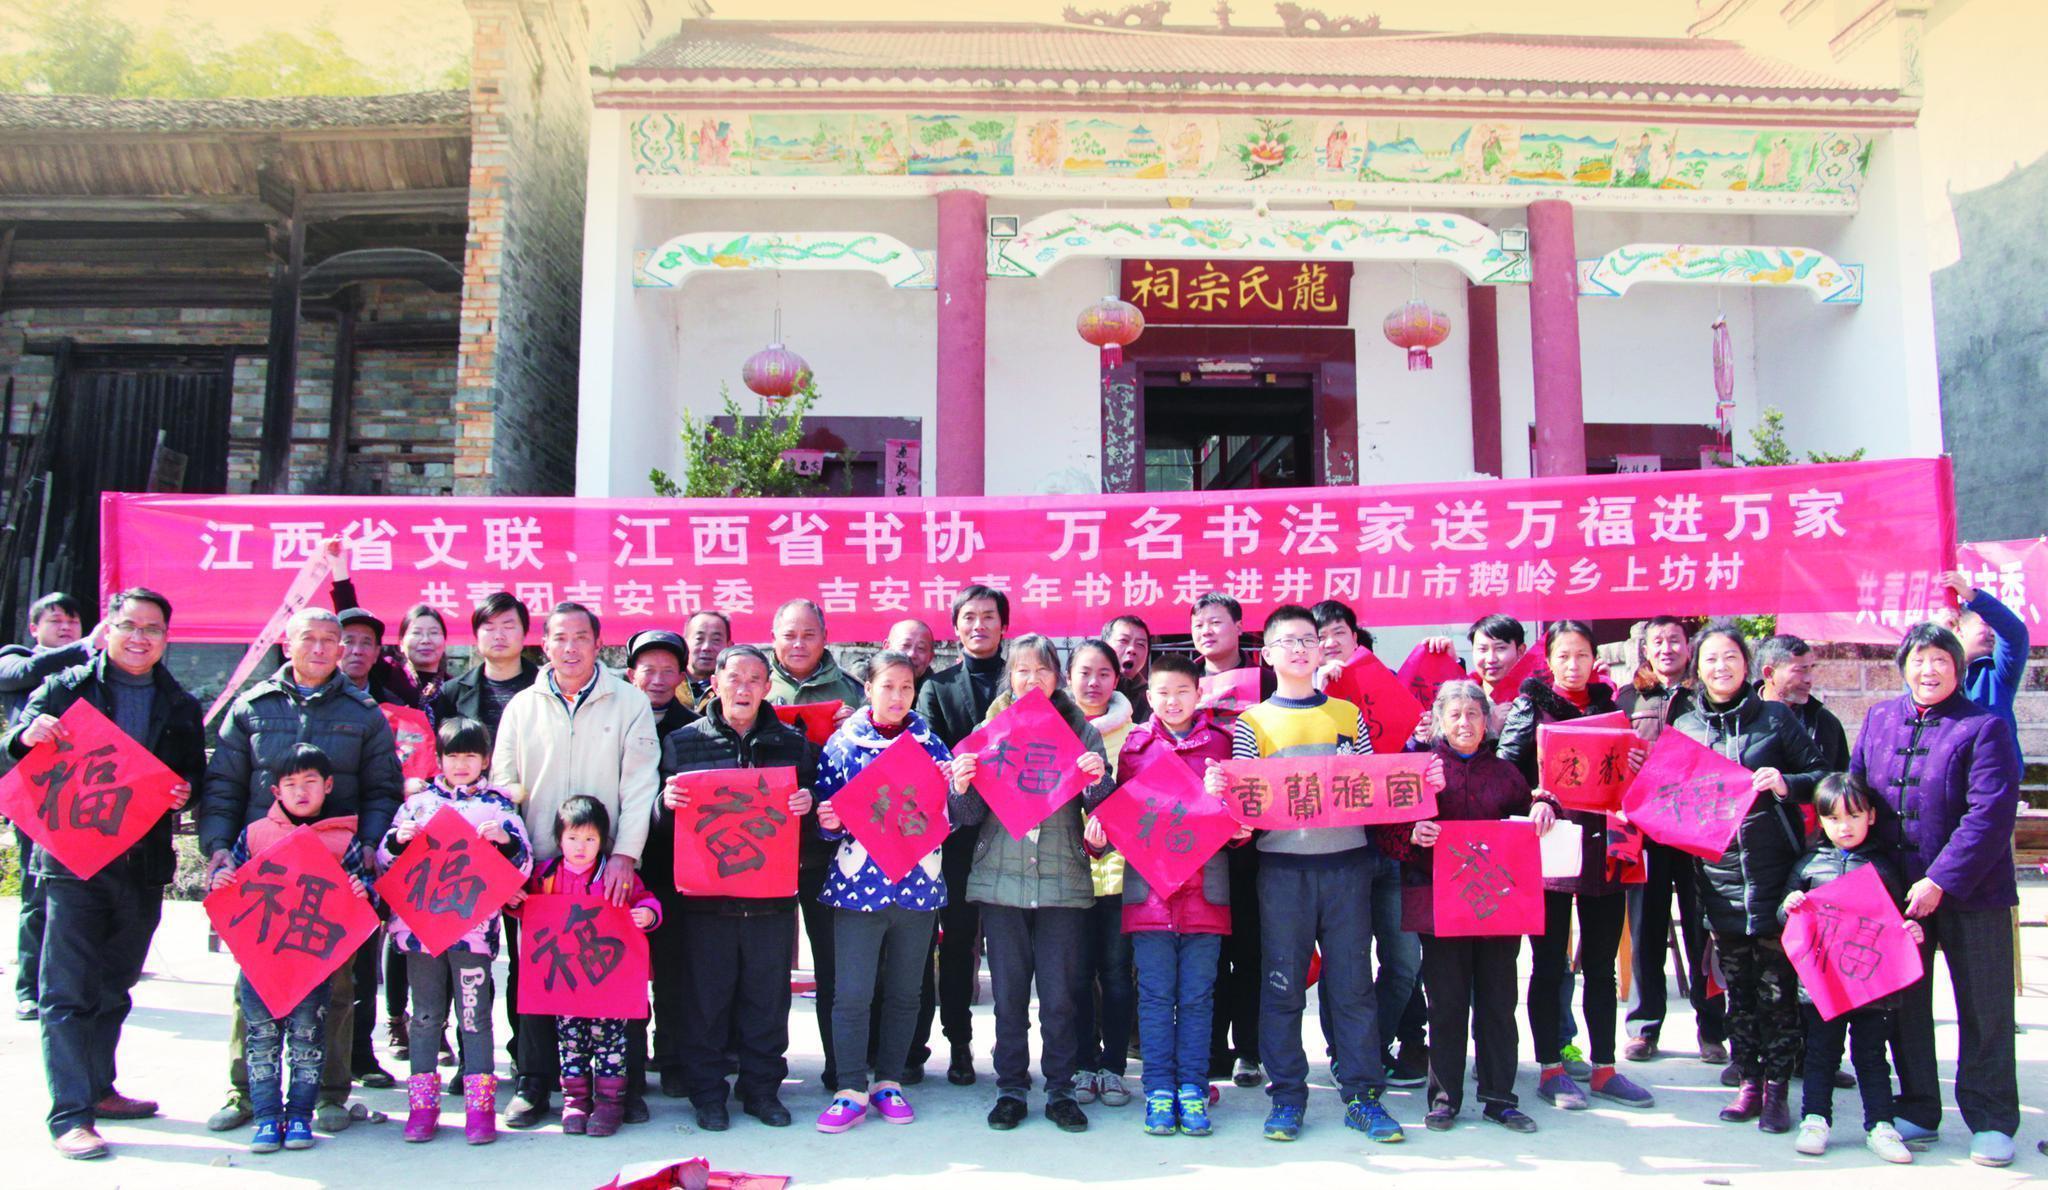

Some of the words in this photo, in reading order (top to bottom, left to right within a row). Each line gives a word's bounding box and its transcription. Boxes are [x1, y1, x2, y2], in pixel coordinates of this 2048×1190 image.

[199, 509, 985, 571] 江西省文联、江西省书协
[1047, 488, 1847, 562] 万名书法家送万福进万家
[31, 737, 133, 836] 福
[981, 740, 1062, 795] 福
[1230, 770, 1424, 821] 香蘭雅室
[1652, 773, 1736, 825] 福
[695, 773, 787, 878] 福
[870, 784, 929, 837] 福
[1137, 797, 1195, 854] 福
[230, 859, 347, 960] 福
[405, 834, 488, 919] 福
[1447, 840, 1517, 921] 福
[531, 904, 626, 992] 福
[1802, 903, 1885, 981] 福
